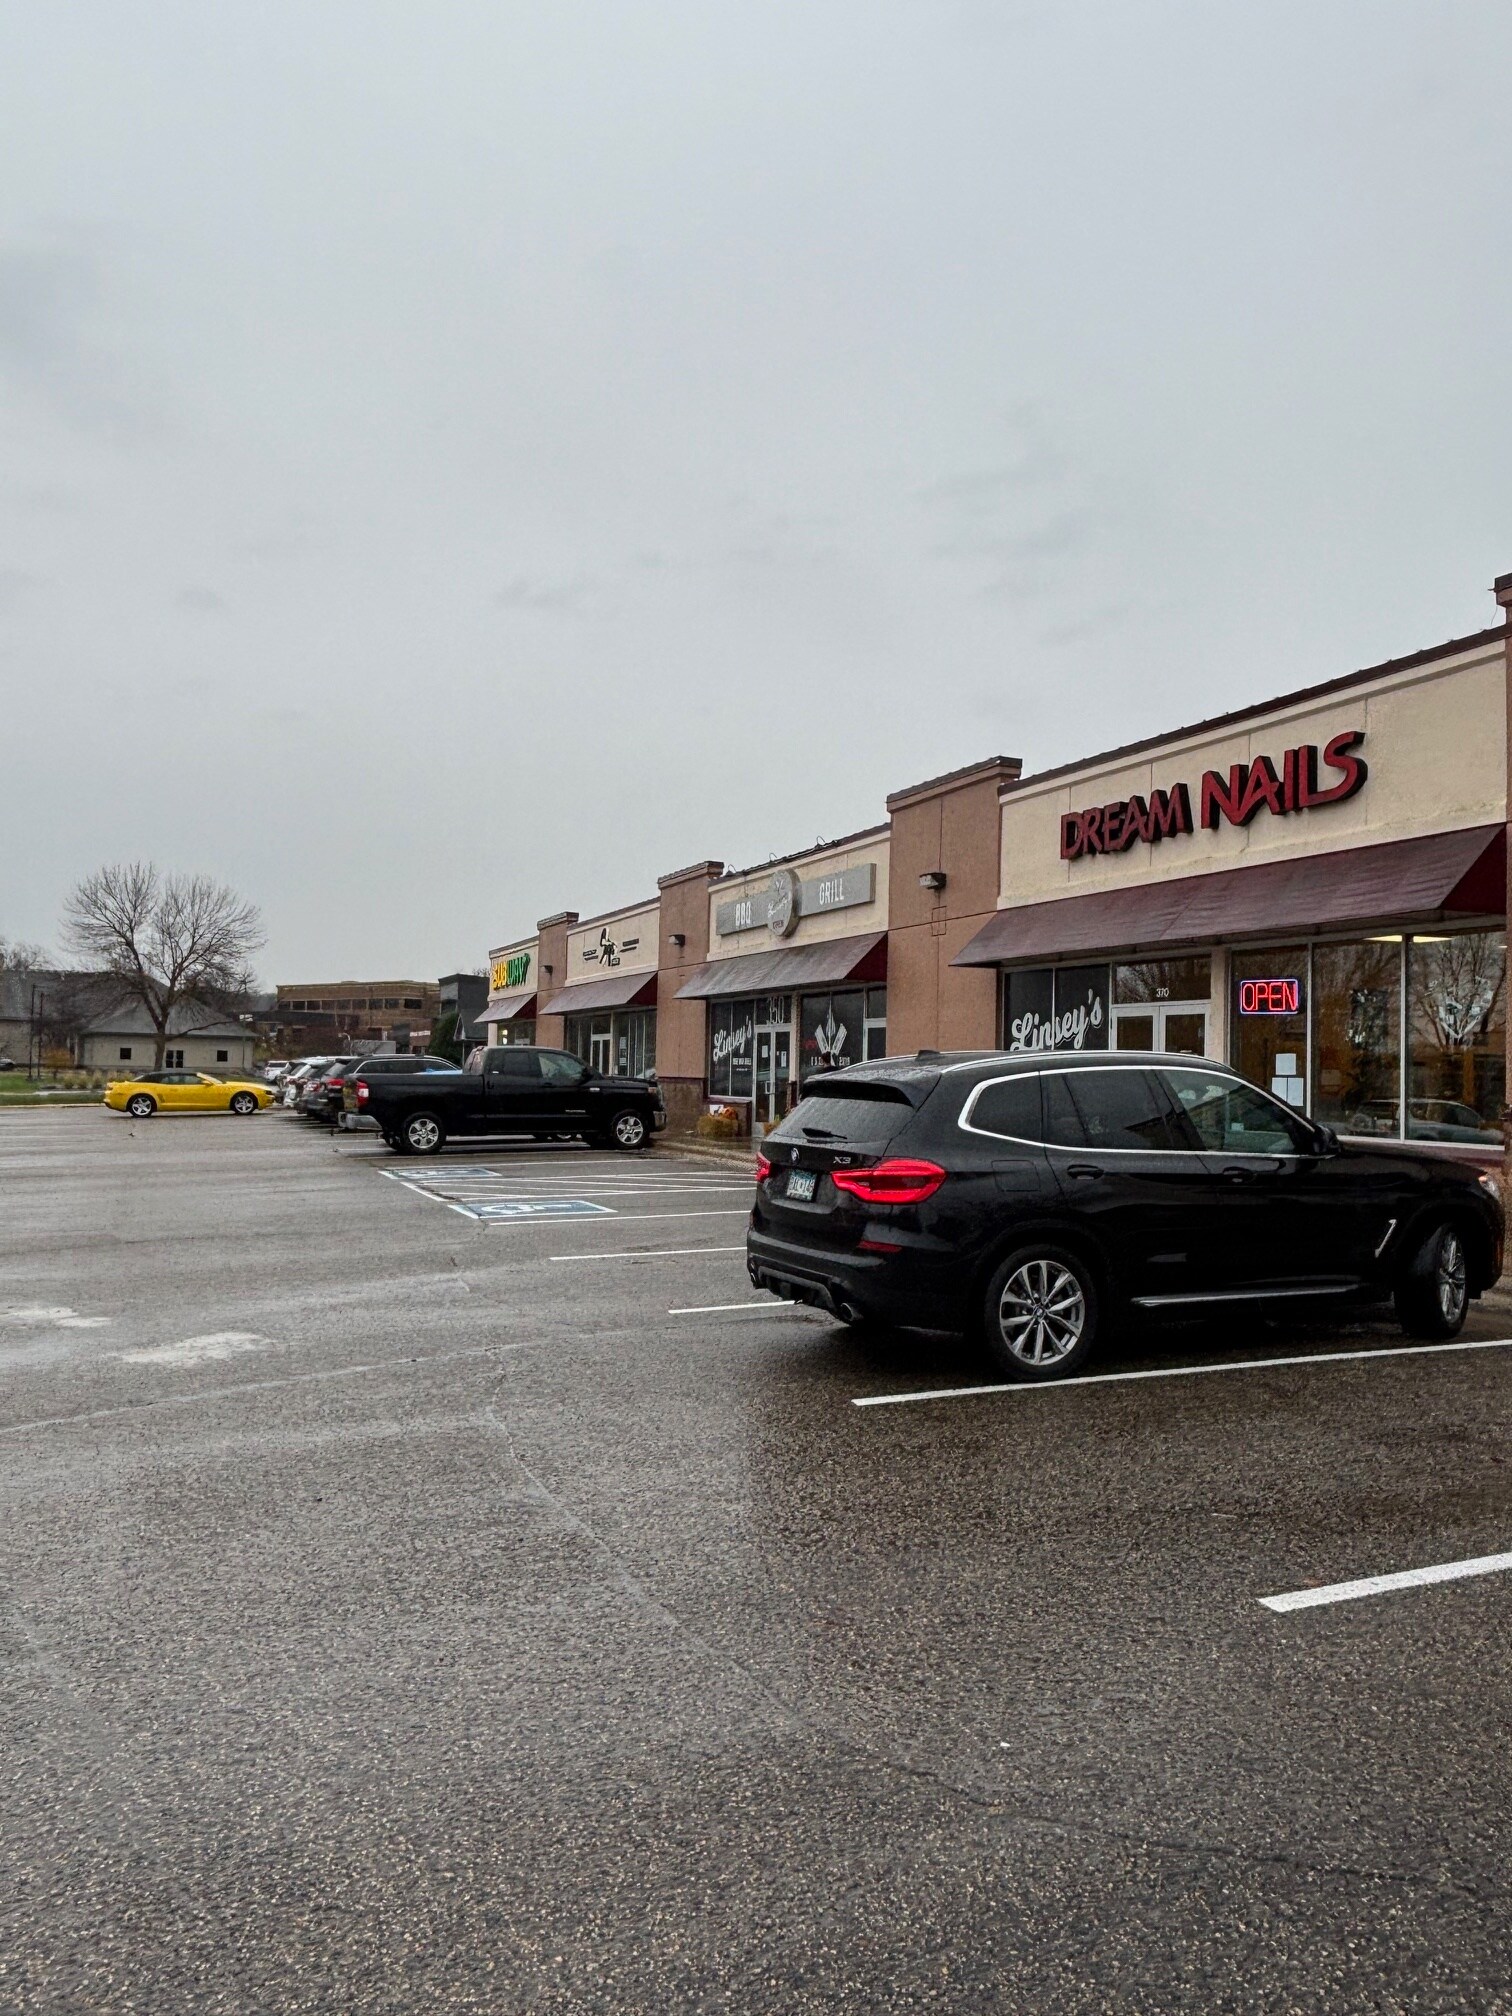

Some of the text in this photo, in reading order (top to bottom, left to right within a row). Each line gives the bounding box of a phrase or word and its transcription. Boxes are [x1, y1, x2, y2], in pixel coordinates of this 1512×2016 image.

[1060, 731, 1367, 859] DREAM NAILS
[819, 878, 844, 905] GRILL
[1156, 988, 1169, 997] 370
[1242, 982, 1297, 1011] OPEN
[1010, 988, 1103, 1051] Linsey's
[833, 1156, 851, 1164] X3
